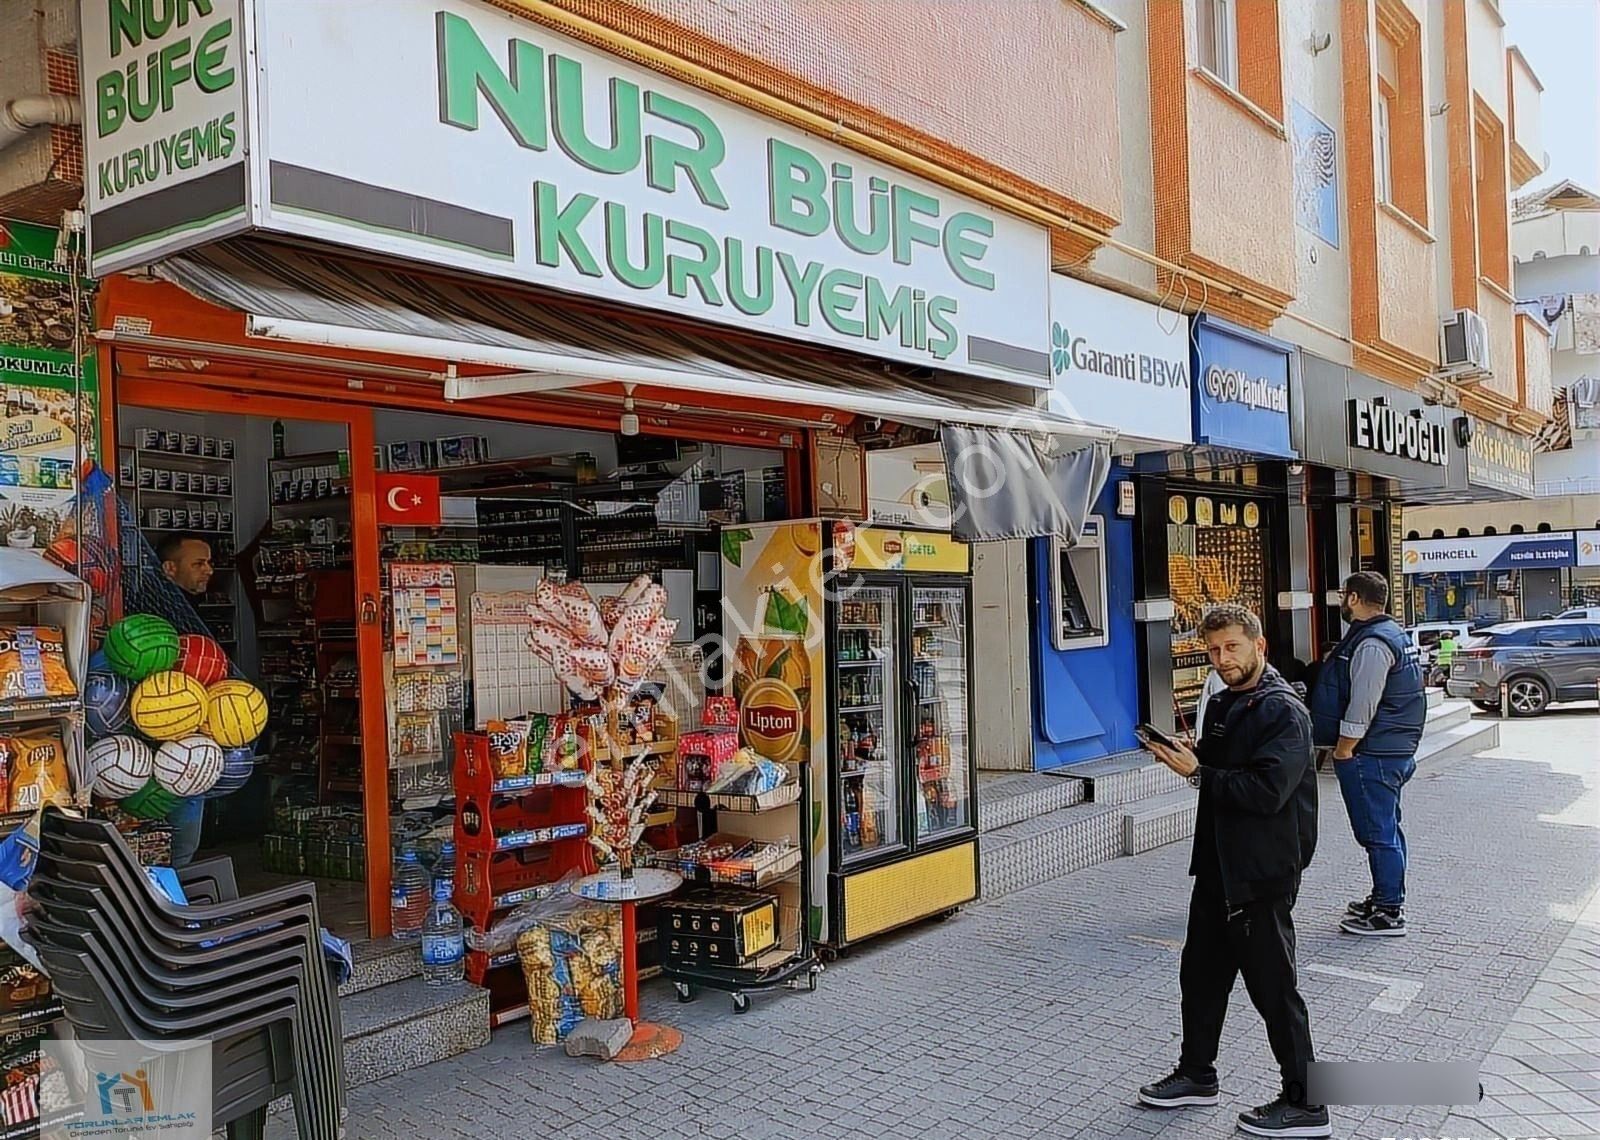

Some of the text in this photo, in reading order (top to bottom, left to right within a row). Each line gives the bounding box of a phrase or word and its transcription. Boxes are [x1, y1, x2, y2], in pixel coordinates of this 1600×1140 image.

[110, 0, 213, 58] NUR
[97, 18, 235, 139] BÜFE
[99, 112, 236, 200] KURUYEMİŞ
[435, 10, 995, 291] NUR BÜFE
[533, 180, 958, 360] KURUYEMİŞ
[1071, 337, 1189, 389] Garanti BBVA
[1352, 396, 1449, 467] EYÜPOĞLU
[1503, 440, 1531, 474] DÖNER
[1420, 549, 1478, 561] TURKCELL
[750, 711, 792, 731] Lipton
[18, 784, 40, 806] 20
